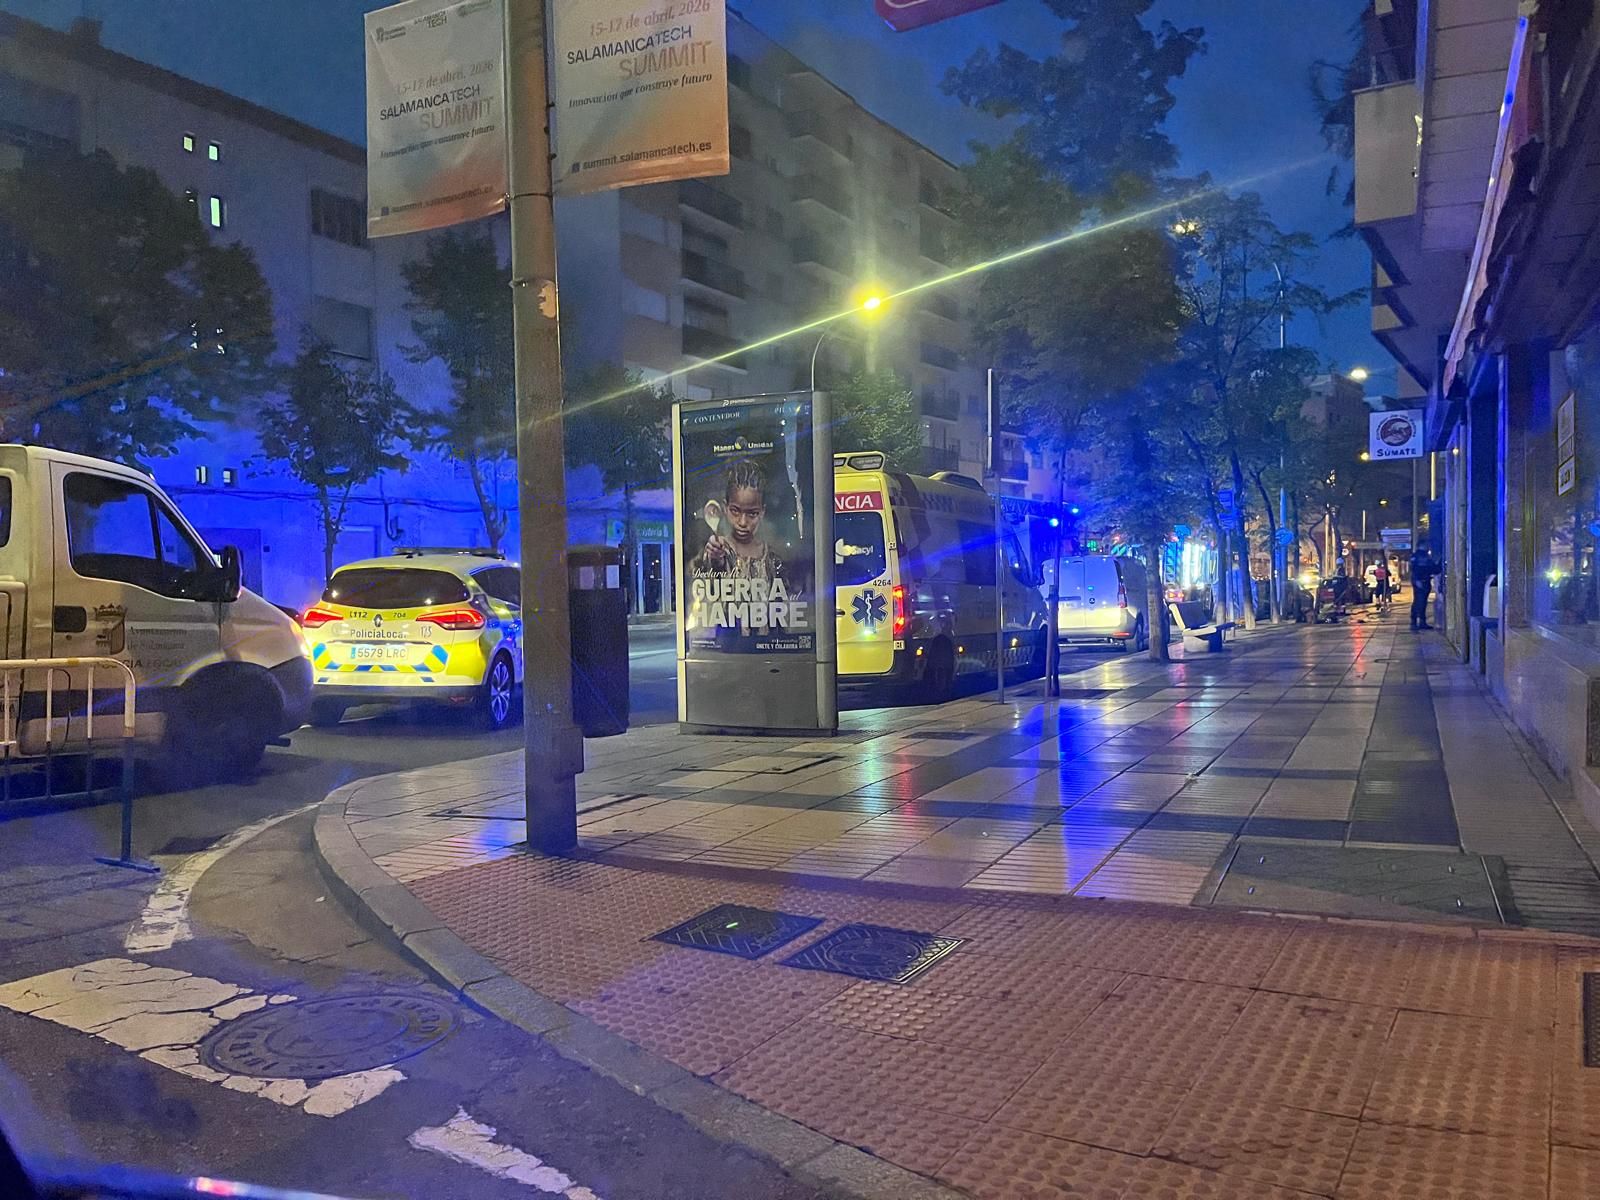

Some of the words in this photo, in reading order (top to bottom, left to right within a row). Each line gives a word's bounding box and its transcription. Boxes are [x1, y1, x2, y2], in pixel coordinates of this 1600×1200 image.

[427, 16, 448, 28] TECH
[625, 14, 640, 29] de
[619, 41, 713, 81] SUMMIT
[620, 87, 634, 99] que
[635, 78, 680, 95] construye
[681, 73, 713, 87] futuro
[420, 96, 494, 129] SUMMIT
[583, 141, 712, 169] summit.salamancatech.es
[713, 444, 735, 453] Manos
[747, 441, 774, 449] Unidas
[692, 567, 728, 579] Declara
[692, 577, 789, 602] GUERRA
[872, 579, 892, 587] 4264
[354, 611, 368, 619] 112
[694, 601, 808, 628] HAMBRE
[357, 648, 383, 659] 5579
[386, 648, 407, 659] LRC
